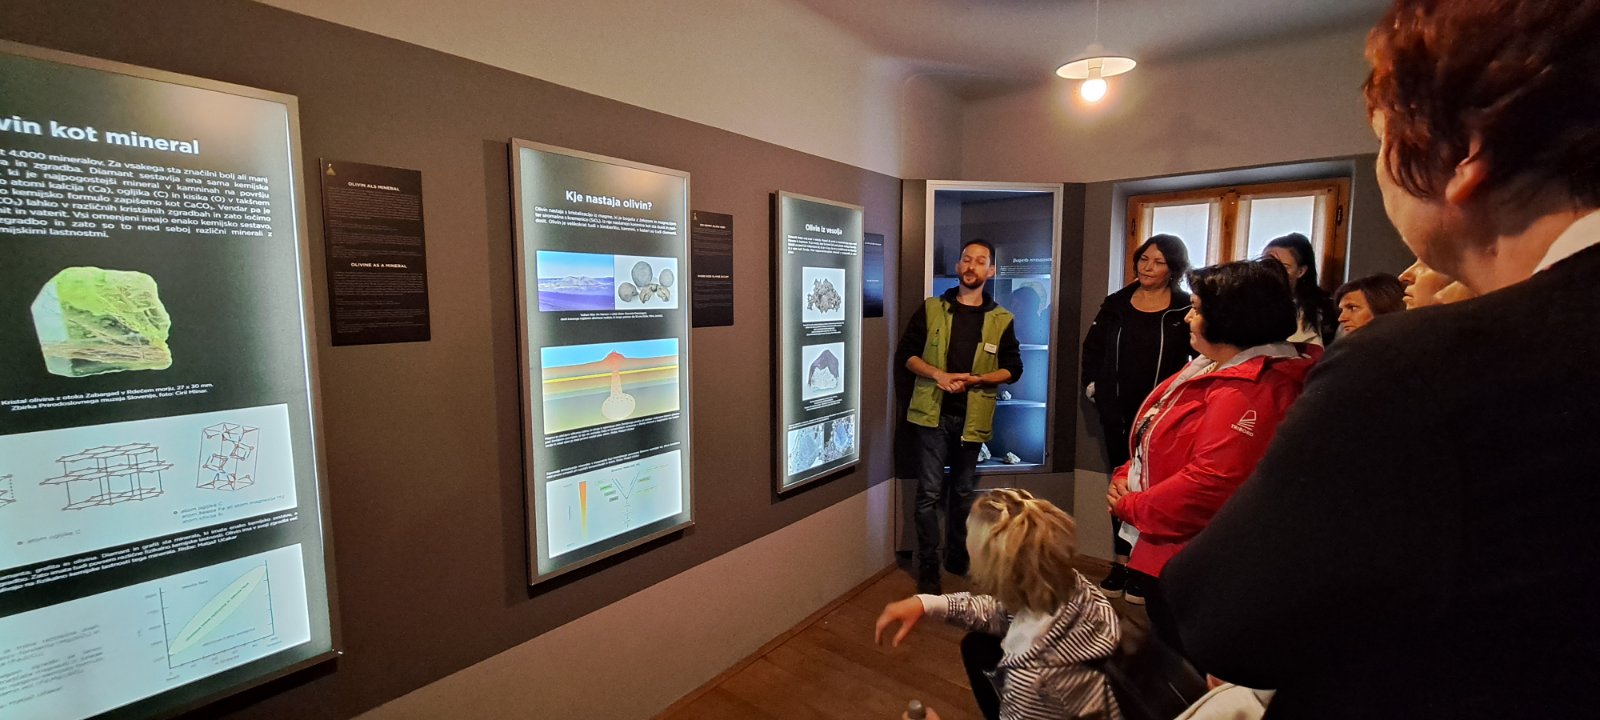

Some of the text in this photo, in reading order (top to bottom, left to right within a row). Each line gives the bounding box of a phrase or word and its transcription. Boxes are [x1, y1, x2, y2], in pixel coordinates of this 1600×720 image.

[50, 120, 99, 142] kot
[105, 131, 199, 155] mineral
[9, 149, 46, 160] 4.000
[49, 155, 106, 167] mineralov.
[107, 160, 122, 168] Za
[124, 162, 165, 173] vsakega
[167, 166, 182, 174] sta
[184, 168, 217, 178] značilni
[219, 171, 235, 180] bolj
[248, 176, 268, 184] manj
[15, 159, 28, 168] in
[89, 167, 134, 178] Diamant
[139, 173, 181, 183] sestavlja
[234, 182, 269, 191] kemijska
[7, 168, 20, 176] ki
[26, 170, 37, 179] je
[44, 173, 117, 185] najpogostejši
[123, 180, 160, 189] mineral
[176, 184, 220, 194] kamninah
[240, 190, 270, 199] površju
[10, 179, 46, 188] atomi
[48, 181, 84, 192] kalcija
[116, 188, 150, 197] ogljika
[153, 190, 169, 199] (C)
[171, 191, 181, 199] in
[183, 192, 208, 201] kisika
[210, 195, 226, 203] (O)
[236, 197, 270, 206] takšnem
[11, 187, 64, 199] kemijsko
[67, 192, 111, 202] formulo
[114, 196, 162, 206] zapišemo
[165, 200, 181, 208] kot
[218, 203, 248, 212] Vendar
[263, 207, 271, 215] je
[26, 199, 59, 208] lahko
[72, 202, 117, 212] različnih
[120, 205, 165, 215] kristalnih
[168, 209, 211, 218] zgradbah
[224, 212, 242, 220] zato
[244, 213, 271, 222] ločimo
[565, 190, 653, 211] Kje nastaja olivin?
[15, 207, 27, 215] in
[72, 210, 89, 219] Vsi
[92, 213, 140, 222] omenjeni
[141, 214, 168, 224] imajo
[171, 217, 198, 225] enako
[201, 219, 238, 228] kemijsko
[54, 219, 66, 227] in
[137, 224, 160, 232] med
[165, 225, 191, 234] seboj
[195, 227, 227, 235] različni
[231, 229, 264, 237] minerali
[805, 223, 821, 232] Olivin
[49, 228, 109, 238] lastnostmi.
